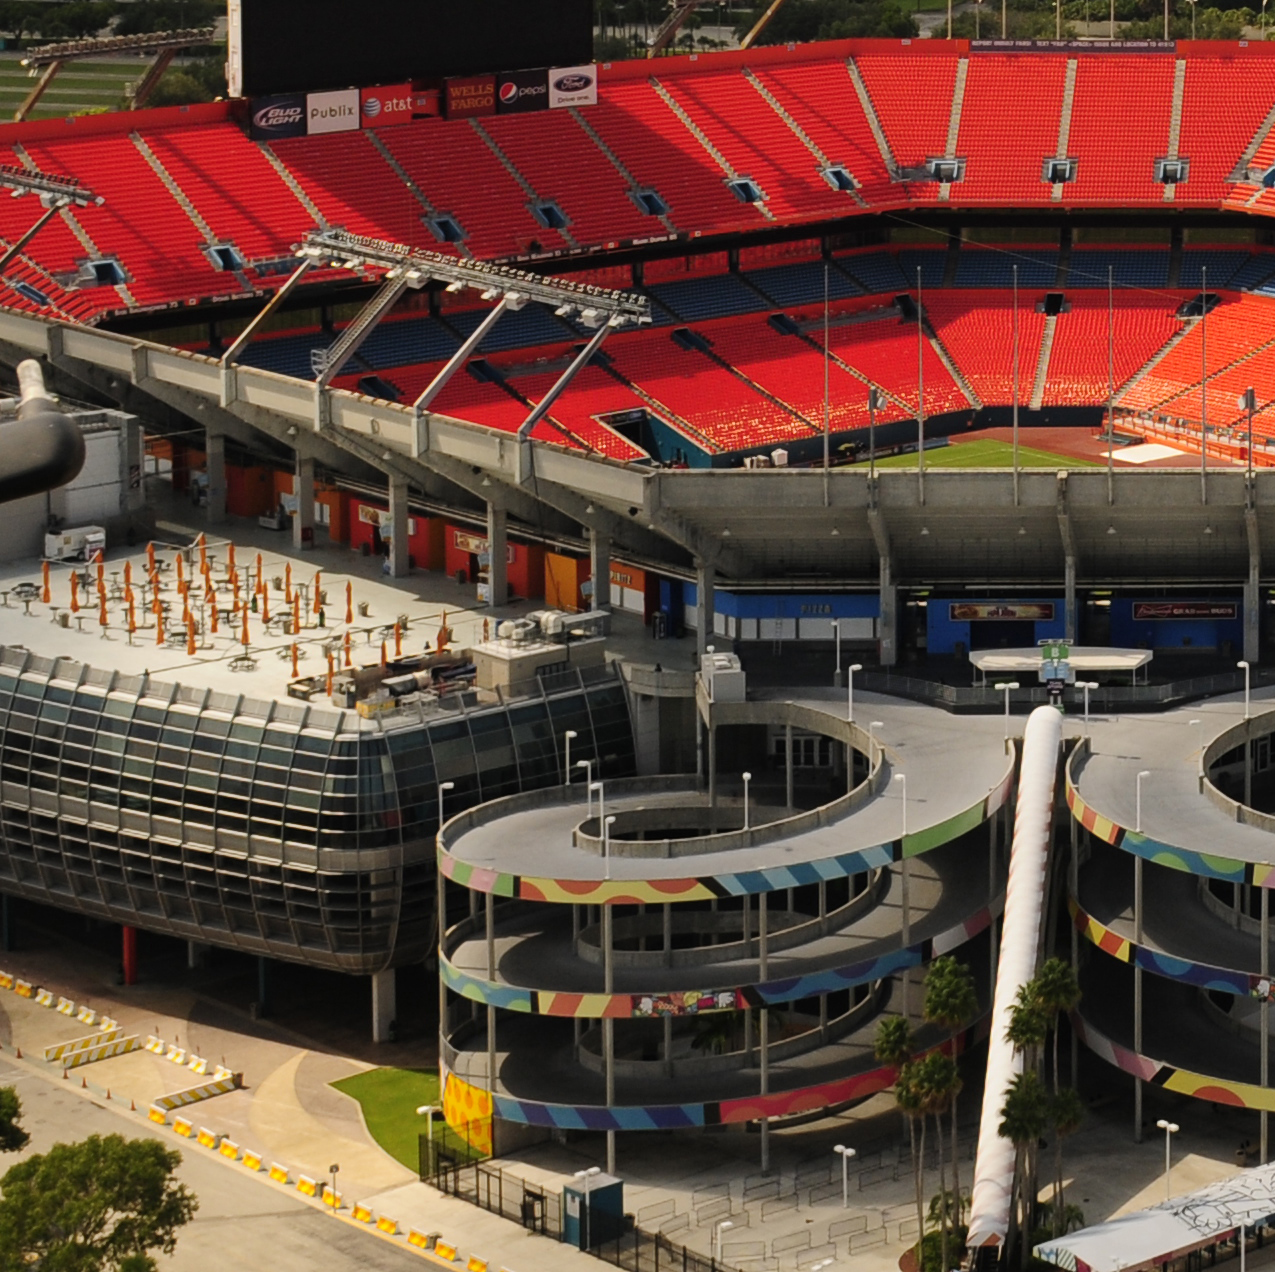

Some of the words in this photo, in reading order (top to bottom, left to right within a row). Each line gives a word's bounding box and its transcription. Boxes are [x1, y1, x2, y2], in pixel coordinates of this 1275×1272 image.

[561, 76, 586, 90] Ford
[450, 84, 494, 97] WELLS
[518, 83, 547, 98] pepsi
[384, 96, 413, 113] at&t
[451, 96, 494, 110] FARGO
[268, 107, 302, 117] BUD
[310, 105, 355, 119] Publix
[260, 114, 304, 126] LIGHT
[801, 604, 832, 614] PIZZA
[1051, 647, 1060, 658] B
